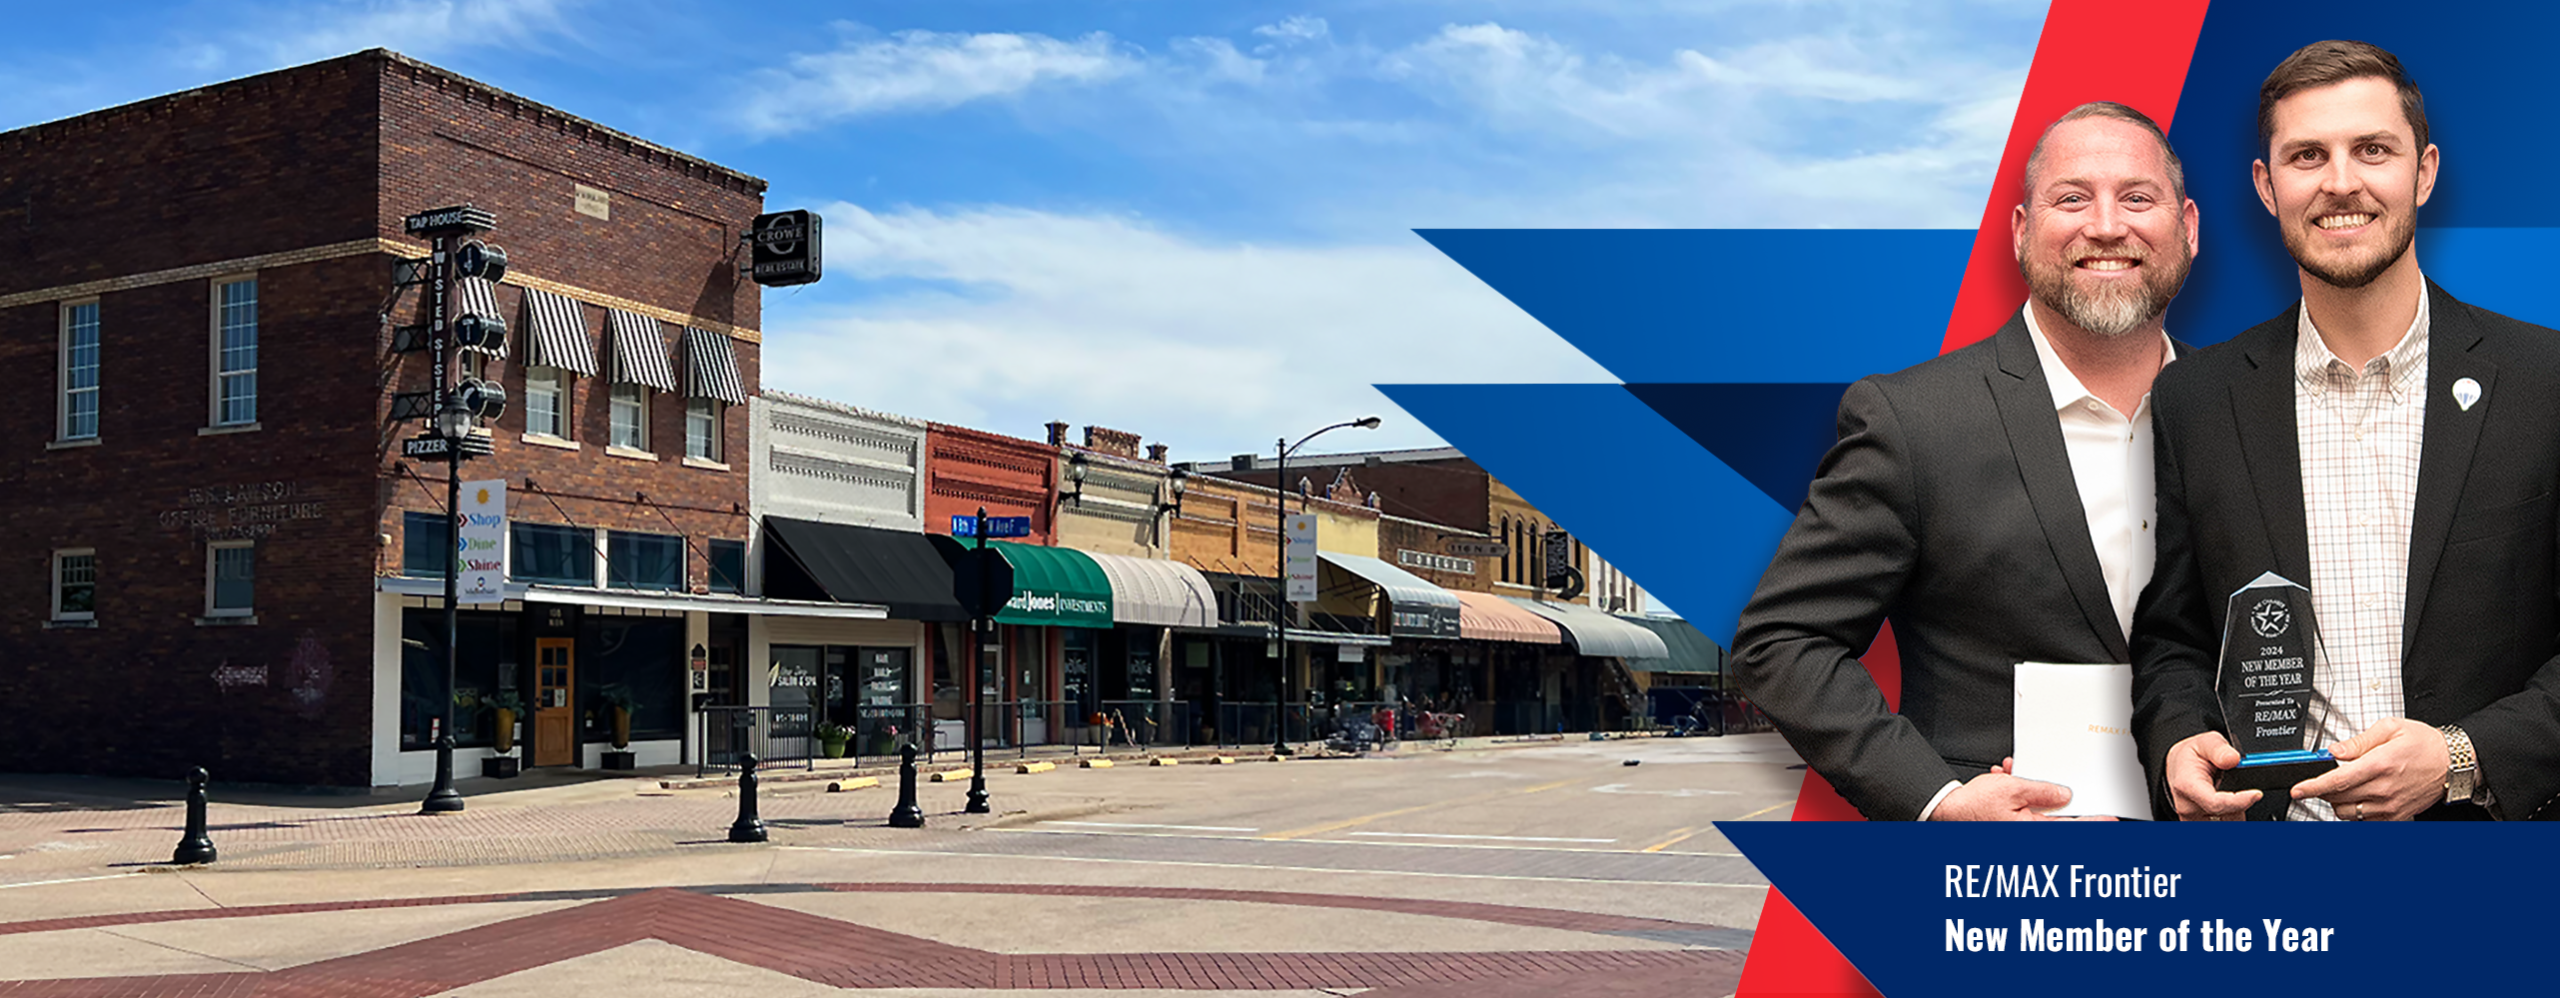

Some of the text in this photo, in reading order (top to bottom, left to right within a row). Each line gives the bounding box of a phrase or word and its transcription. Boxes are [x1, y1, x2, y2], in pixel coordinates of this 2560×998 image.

[409, 210, 463, 230] TAP HOUSE
[756, 226, 804, 243] CROWE
[433, 237, 446, 332] TWISTED
[227, 501, 324, 524] FURNITURE
[468, 512, 501, 528] Shop
[468, 537, 497, 551] Dine
[467, 559, 501, 572] Shine
[2260, 645, 2284, 657] 2024
[2241, 657, 2304, 673] NEW MEMBER
[2244, 672, 2303, 689] OF THE YEAR
[2255, 697, 2295, 708] Presented To
[2254, 709, 2297, 723] RE/MAX
[2088, 723, 2121, 736] REMAX
[2255, 724, 2298, 738] Frontier
